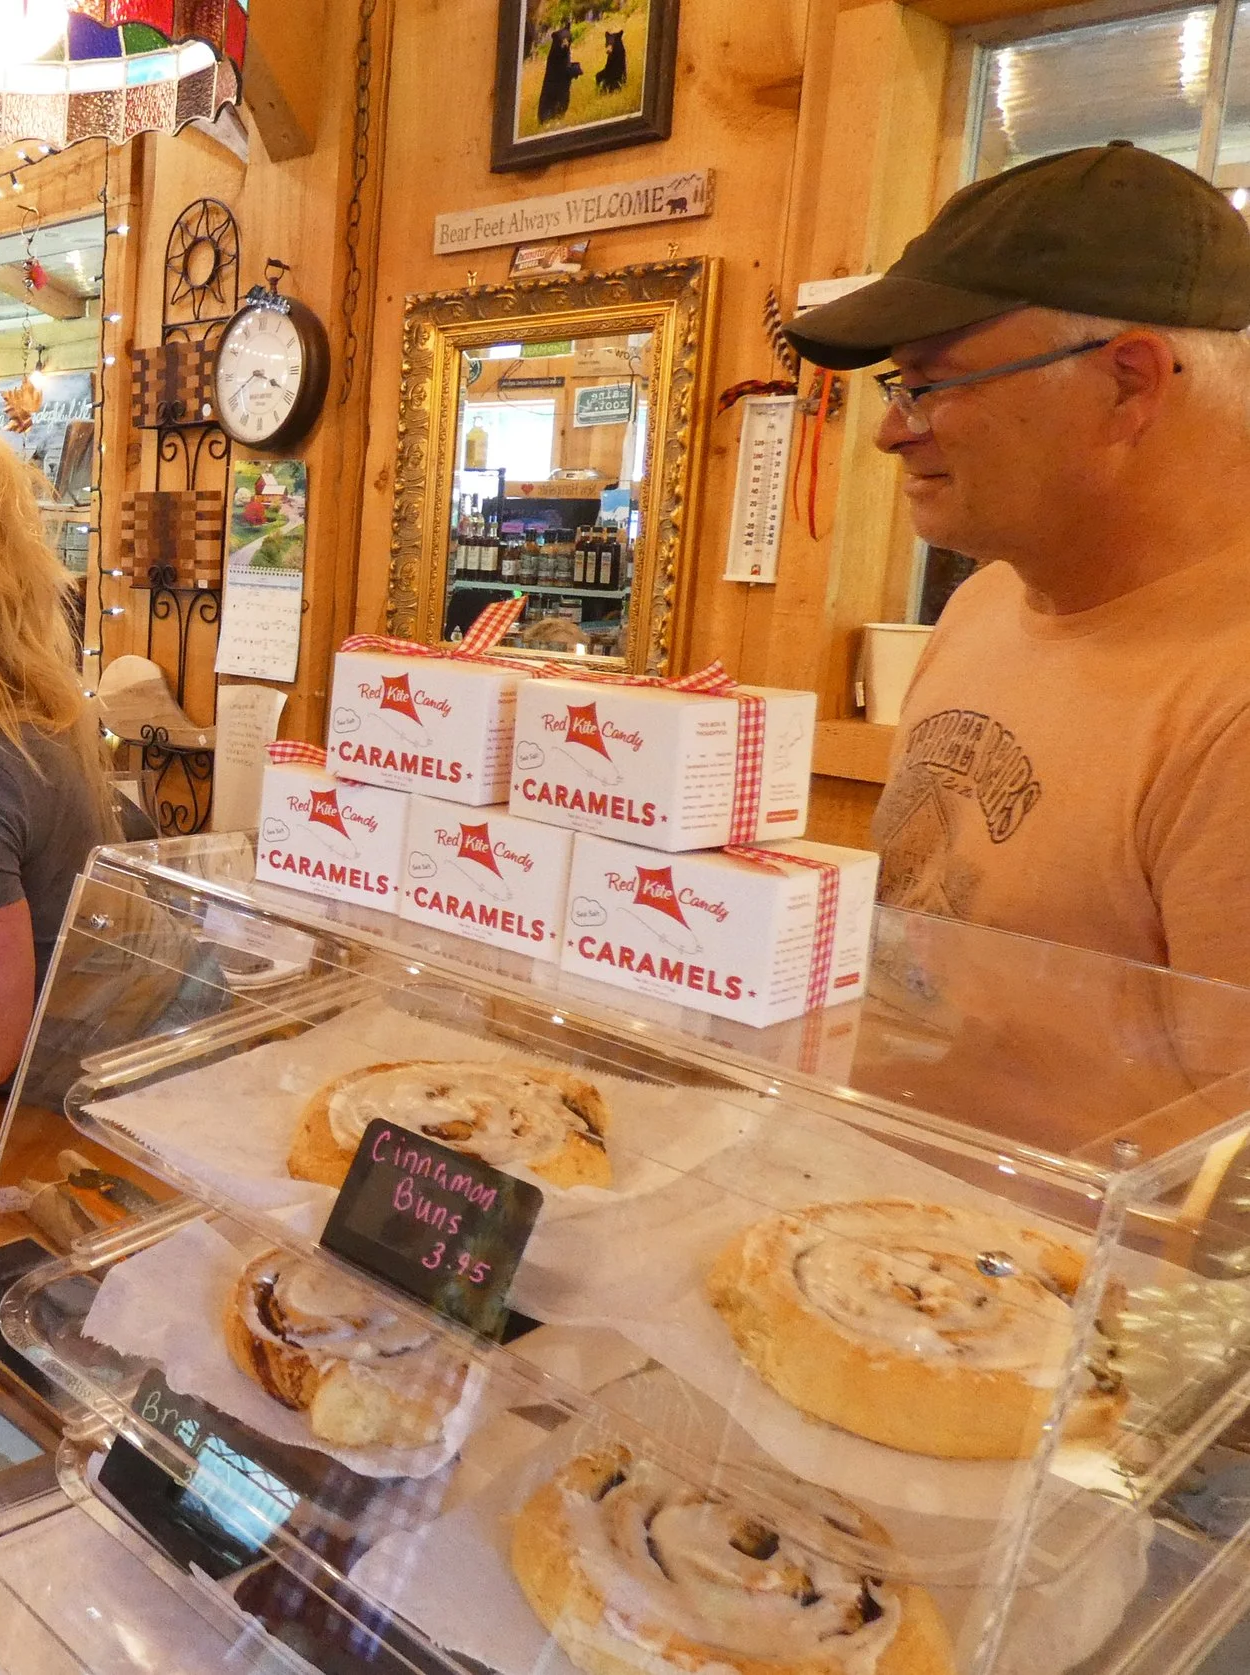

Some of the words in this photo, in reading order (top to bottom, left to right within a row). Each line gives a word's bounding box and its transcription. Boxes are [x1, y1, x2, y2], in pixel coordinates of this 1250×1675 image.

[439, 224, 471, 245] Bear
[474, 217, 505, 239] Feet
[508, 209, 561, 235] Always
[566, 186, 666, 225] WELCOME
[358, 683, 382, 699] Red
[386, 686, 410, 703] Kite
[414, 690, 451, 717] Candy
[541, 714, 568, 732] Red
[572, 716, 598, 735] Kite
[601, 721, 644, 752] Candy
[338, 741, 463, 783] CARAMELS
[287, 796, 311, 812] Red
[316, 800, 339, 817] Kite
[341, 805, 379, 833] Candy
[522, 778, 657, 827] CARAMELS
[268, 849, 390, 895] CARAMELS
[434, 829, 460, 847] Red
[465, 834, 490, 854] Kite
[493, 841, 535, 872] Candy
[414, 886, 546, 942] CARAMELS
[604, 872, 637, 893] Red
[642, 879, 674, 900] Kite
[678, 887, 730, 922] Candy
[578, 935, 743, 1001] CARAMELS
[372, 1130, 498, 1212] Cinnamon
[393, 1177, 463, 1234] Buns
[421, 1242, 492, 1283] 3.95
